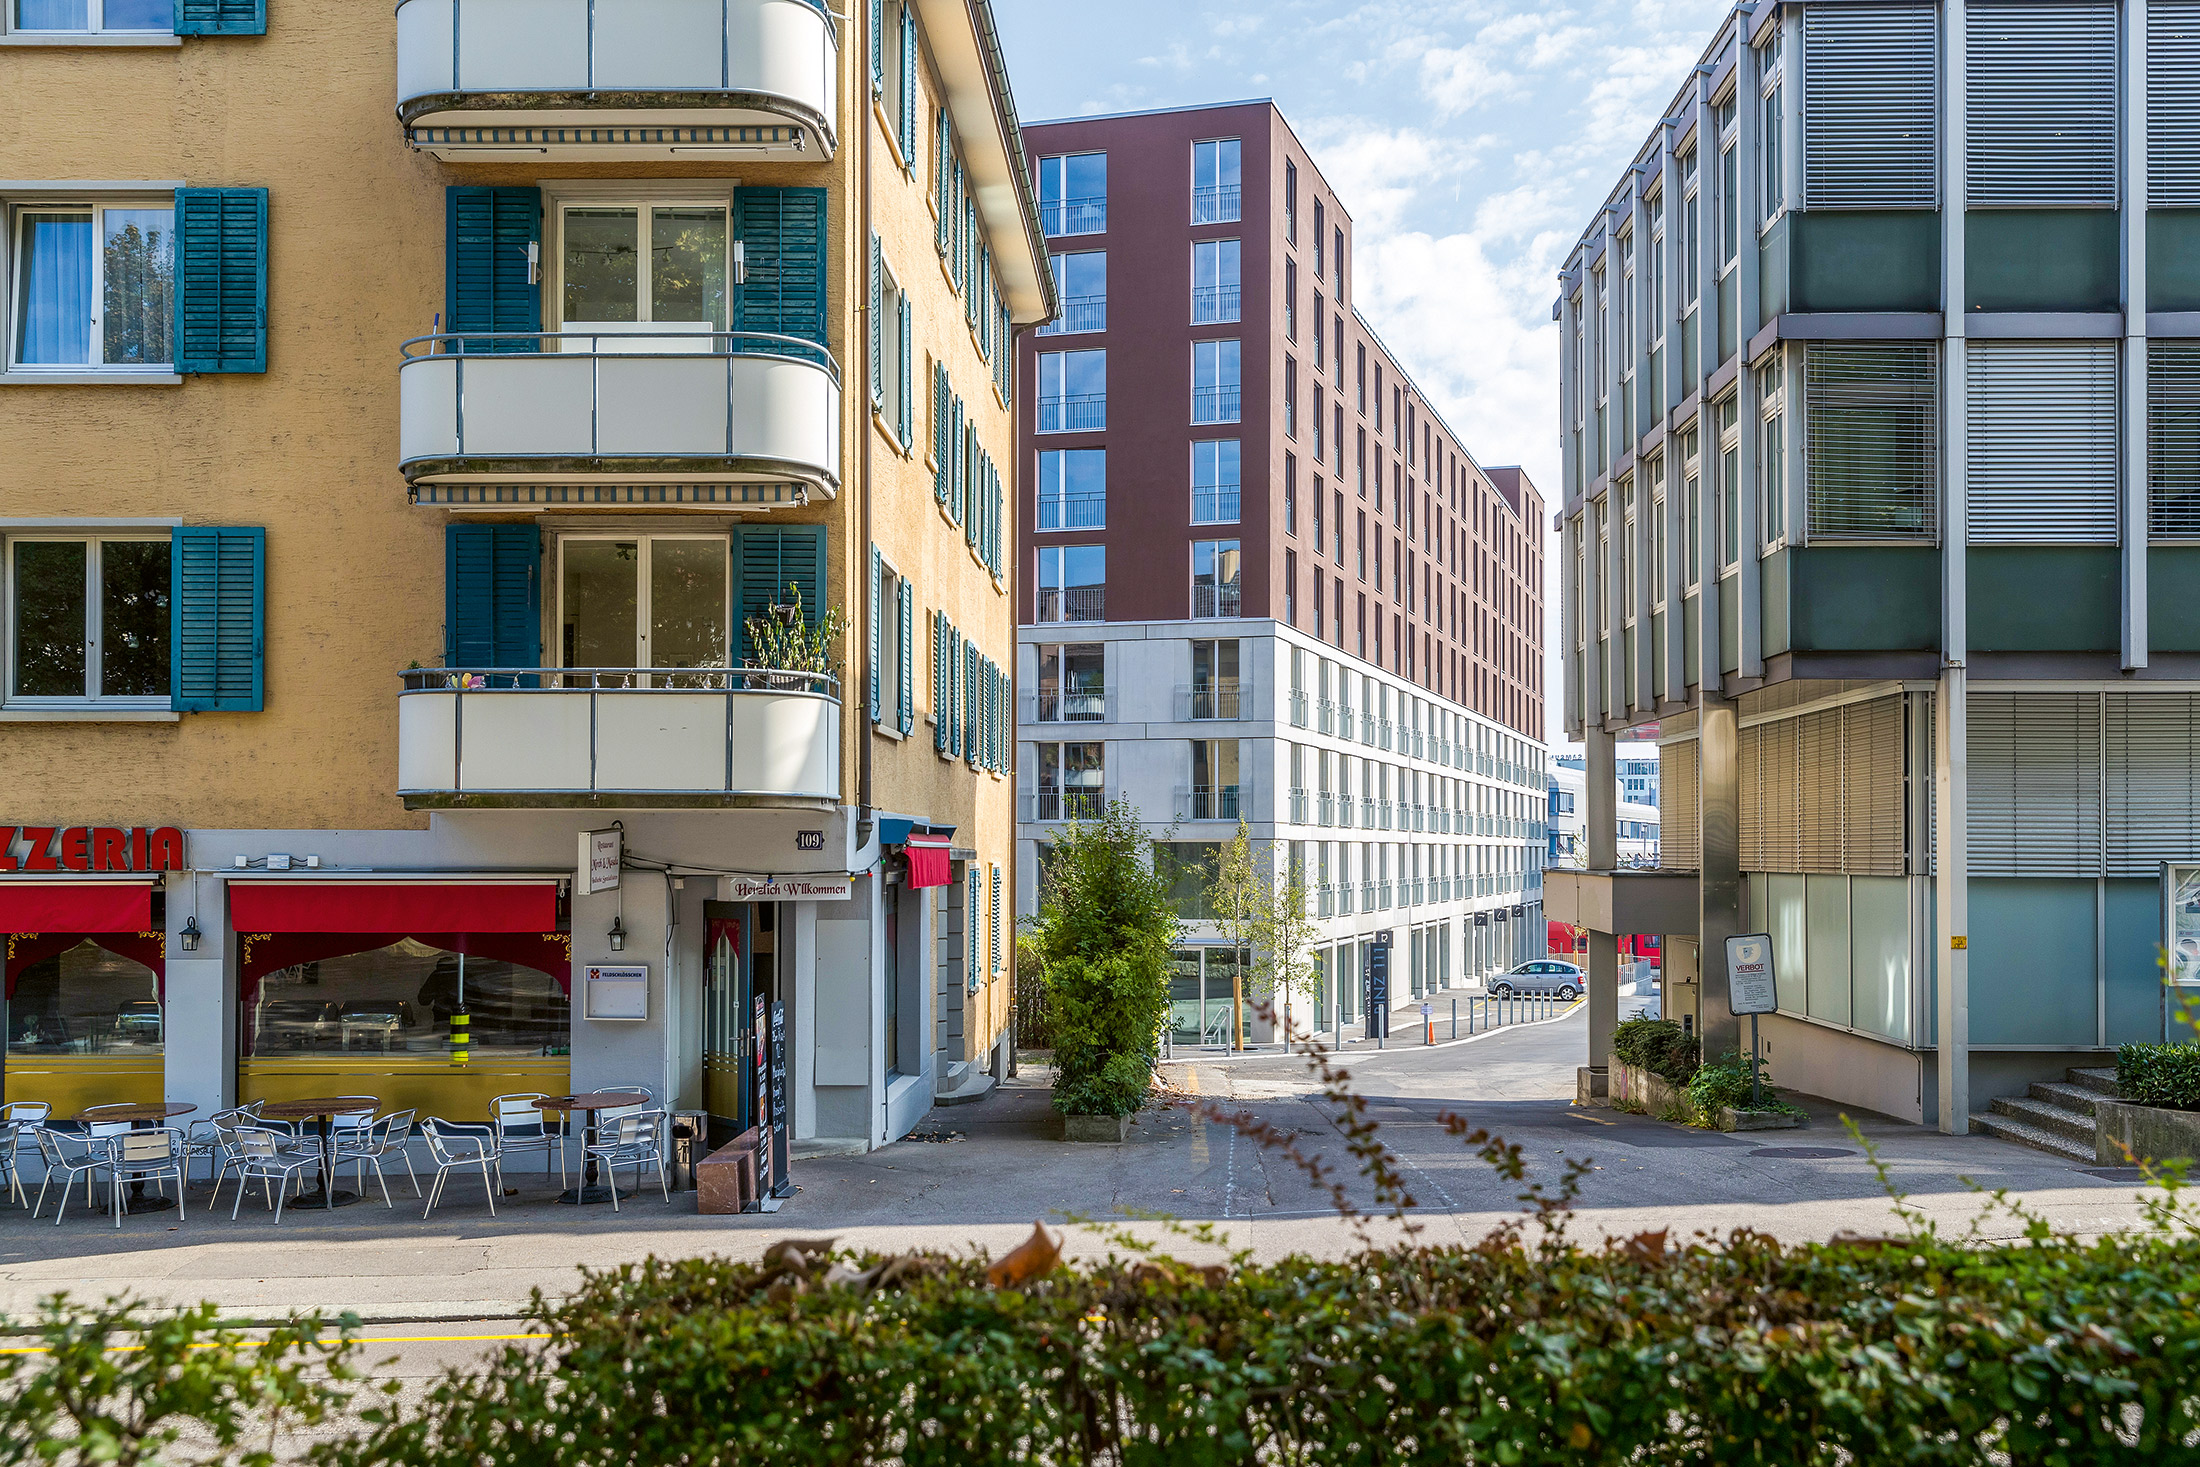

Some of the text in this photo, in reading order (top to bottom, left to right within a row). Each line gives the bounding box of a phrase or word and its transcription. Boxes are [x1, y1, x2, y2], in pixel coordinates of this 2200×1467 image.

[801, 834, 819, 847] 109
[735, 882, 781, 896] Herzlich
[1374, 948, 1385, 969] 111
